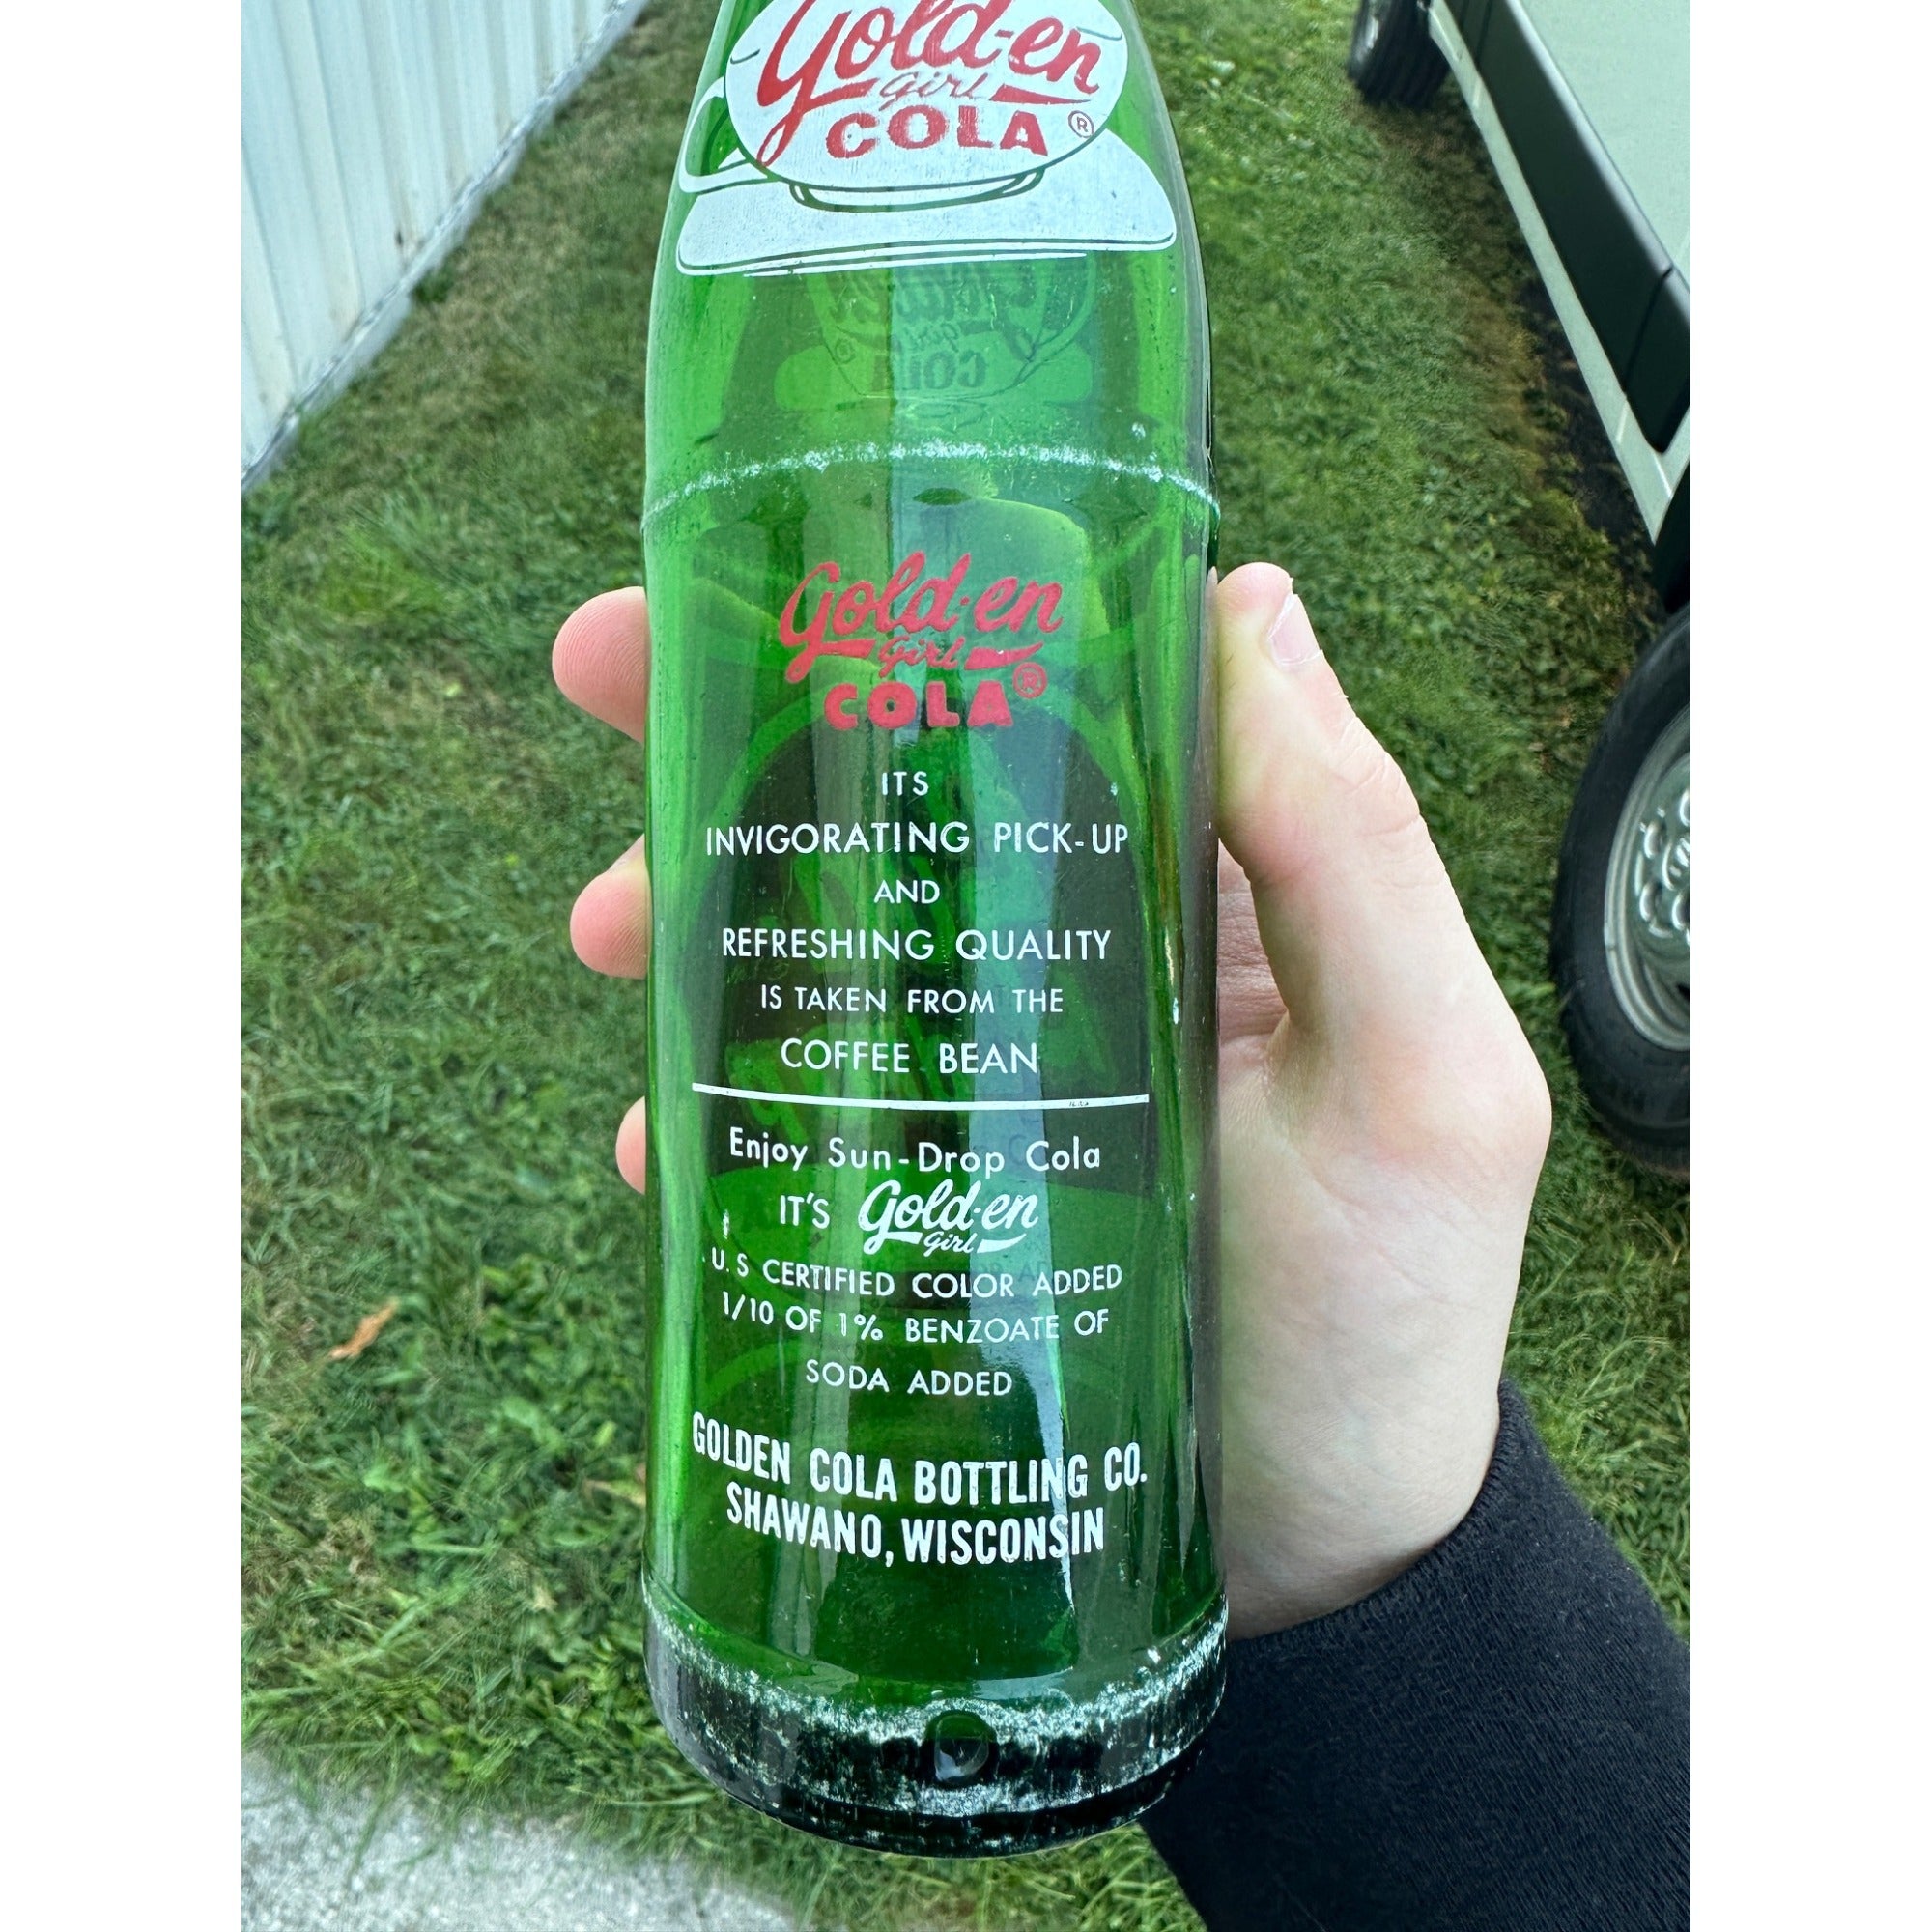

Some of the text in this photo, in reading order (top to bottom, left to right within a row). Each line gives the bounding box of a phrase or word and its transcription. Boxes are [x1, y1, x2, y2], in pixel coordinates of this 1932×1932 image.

[825, 105, 1049, 158] COLA
[824, 681, 1012, 729] COLA
[881, 771, 929, 796] ITS
[706, 821, 1128, 856] INVIGORATING PICK-UP
[874, 879, 940, 904] AND
[723, 927, 1111, 961] REFRESHING QUALITY
[761, 984, 1064, 1014] IS TAKEN FROM THE
[781, 1037, 1037, 1074] COFFEE BEAN
[729, 1126, 808, 1171] Enjoy
[1026, 1135, 1100, 1172] Cola
[780, 1192, 830, 1229] IT'S
[762, 1259, 895, 1296] CERTIFIED
[912, 1273, 1014, 1299] COLOR
[1032, 1264, 1122, 1296] ADDED
[723, 1291, 774, 1325] 1/10
[785, 1305, 821, 1333] OF
[905, 1316, 1060, 1344] BENZOATE
[1074, 1308, 1109, 1336] OF
[806, 1359, 1012, 1396] SODA ADDED
[693, 1411, 1148, 1506] GOLDEN COLA BOTTLING CO.
[726, 1482, 1104, 1568] SHAWANO, WISCONSIN
